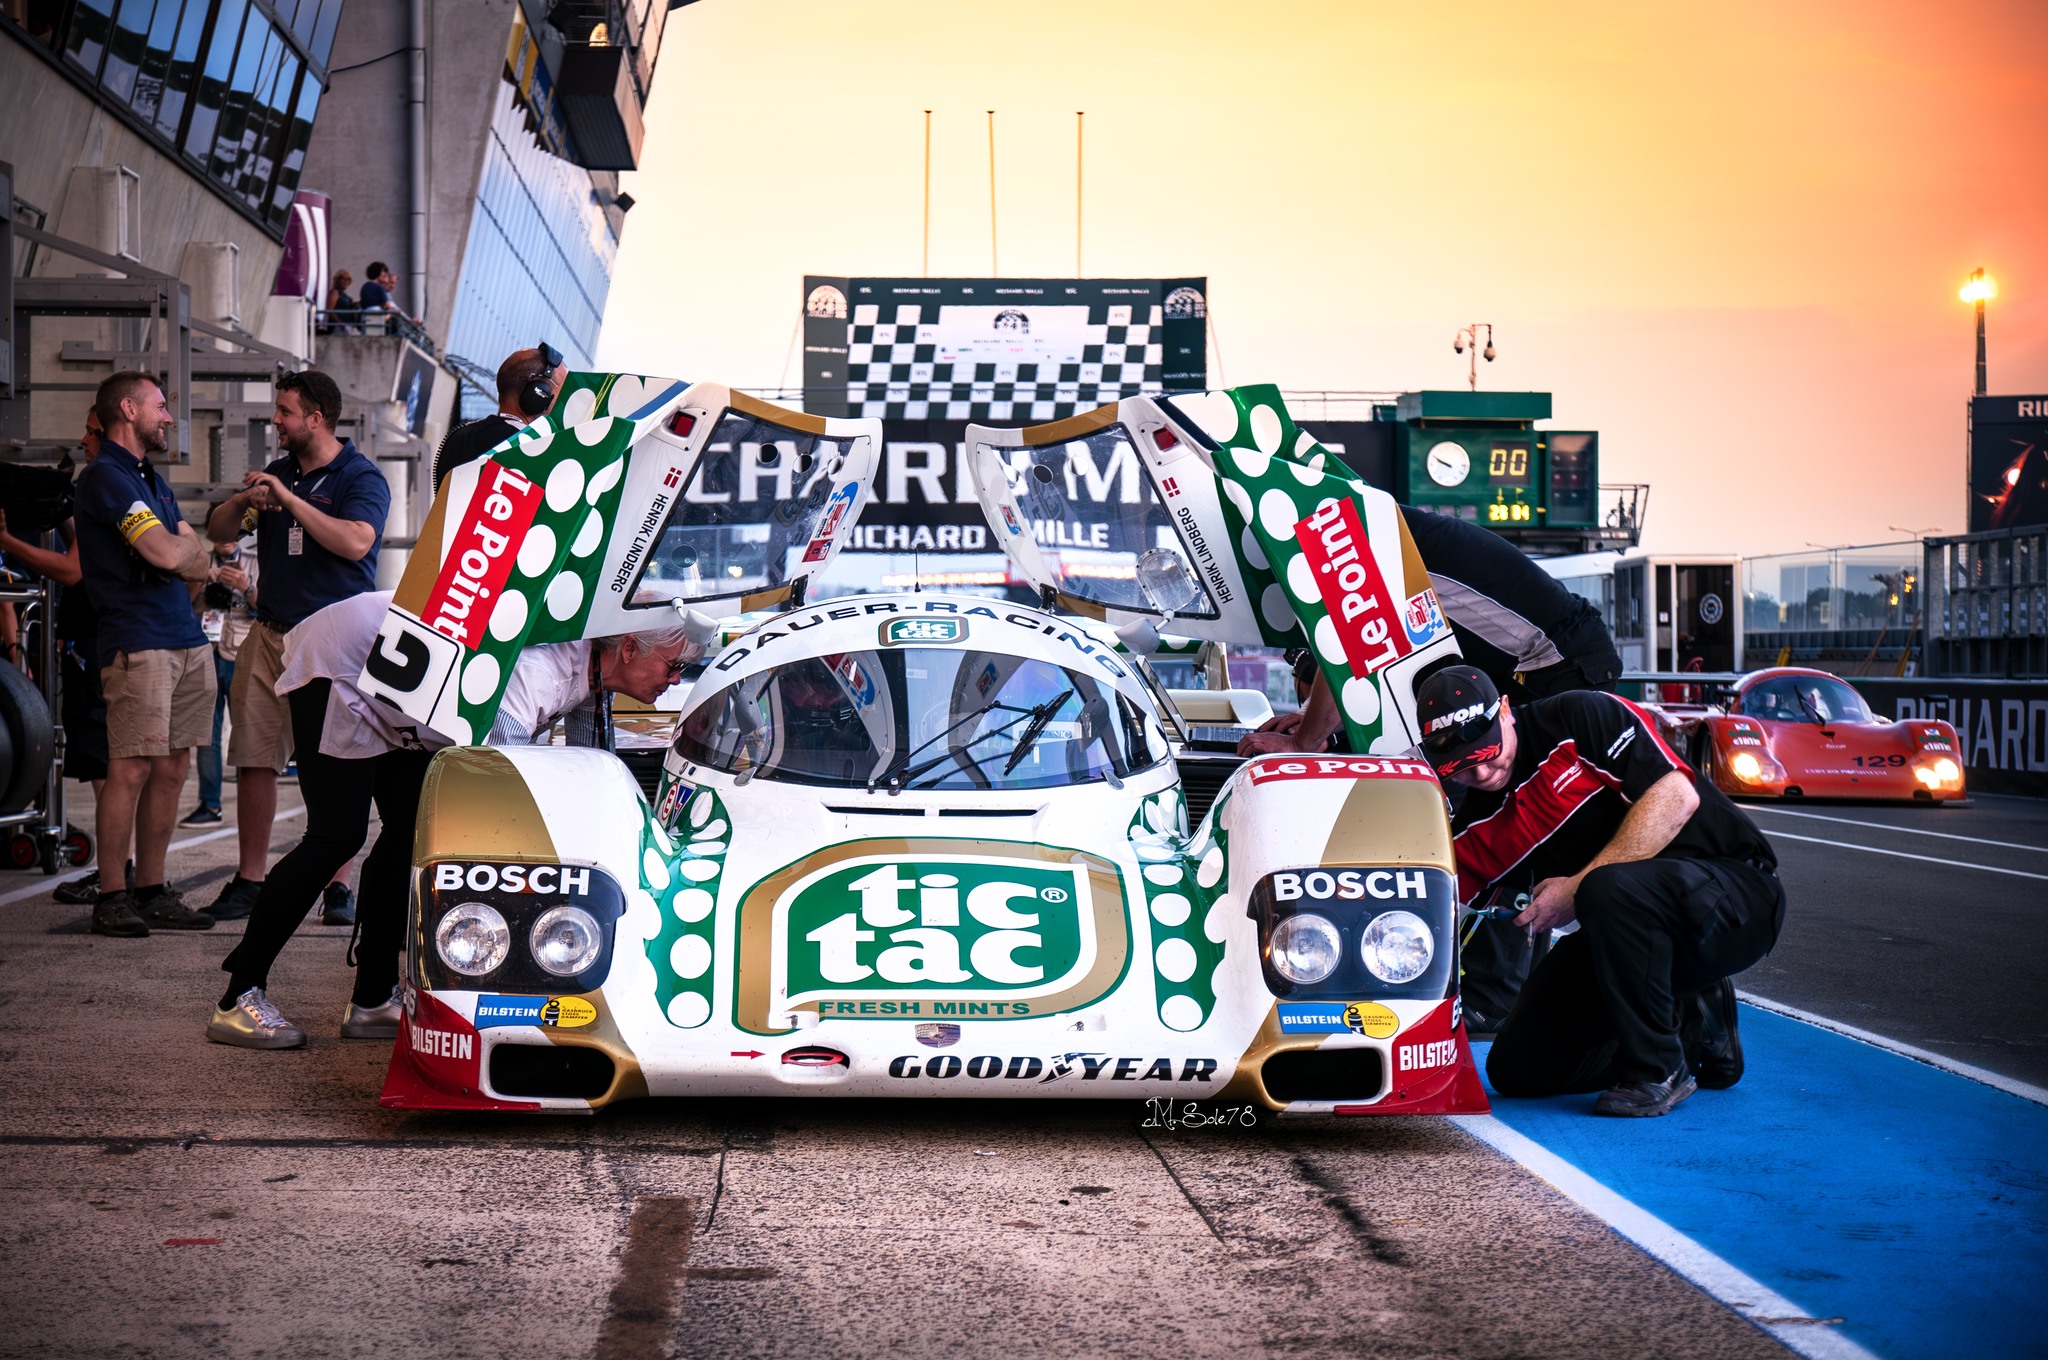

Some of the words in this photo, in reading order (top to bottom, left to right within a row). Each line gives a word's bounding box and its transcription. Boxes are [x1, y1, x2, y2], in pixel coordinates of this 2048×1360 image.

[1489, 449, 1527, 476] 00
[484, 466, 532, 522] Le
[636, 493, 669, 537] HENRIK
[1176, 507, 1213, 561] LINDBERG
[610, 538, 645, 594] LINDBERG
[1306, 500, 1378, 623] Point
[433, 522, 511, 640] Point
[1203, 560, 1234, 604] HENRIK
[895, 628, 949, 639] tac
[904, 621, 948, 631] tic
[1359, 618, 1400, 673] Le
[1430, 703, 1484, 732] AVON
[1251, 762, 1307, 780] Le
[1314, 760, 1435, 778] Poin
[1851, 754, 1906, 768] 129
[434, 864, 590, 896] BOSCH
[848, 864, 1040, 929] tic
[1274, 871, 1427, 901] BOSCH
[806, 912, 1044, 984] tac
[478, 1007, 539, 1017] BILSTEIN
[818, 1000, 920, 1016] FRESH
[933, 1001, 1031, 1016] MINTS
[1282, 1015, 1341, 1025] BILSTEIN
[411, 1025, 473, 1060] BILSTEIN
[1400, 1038, 1458, 1071] BILSTEIN
